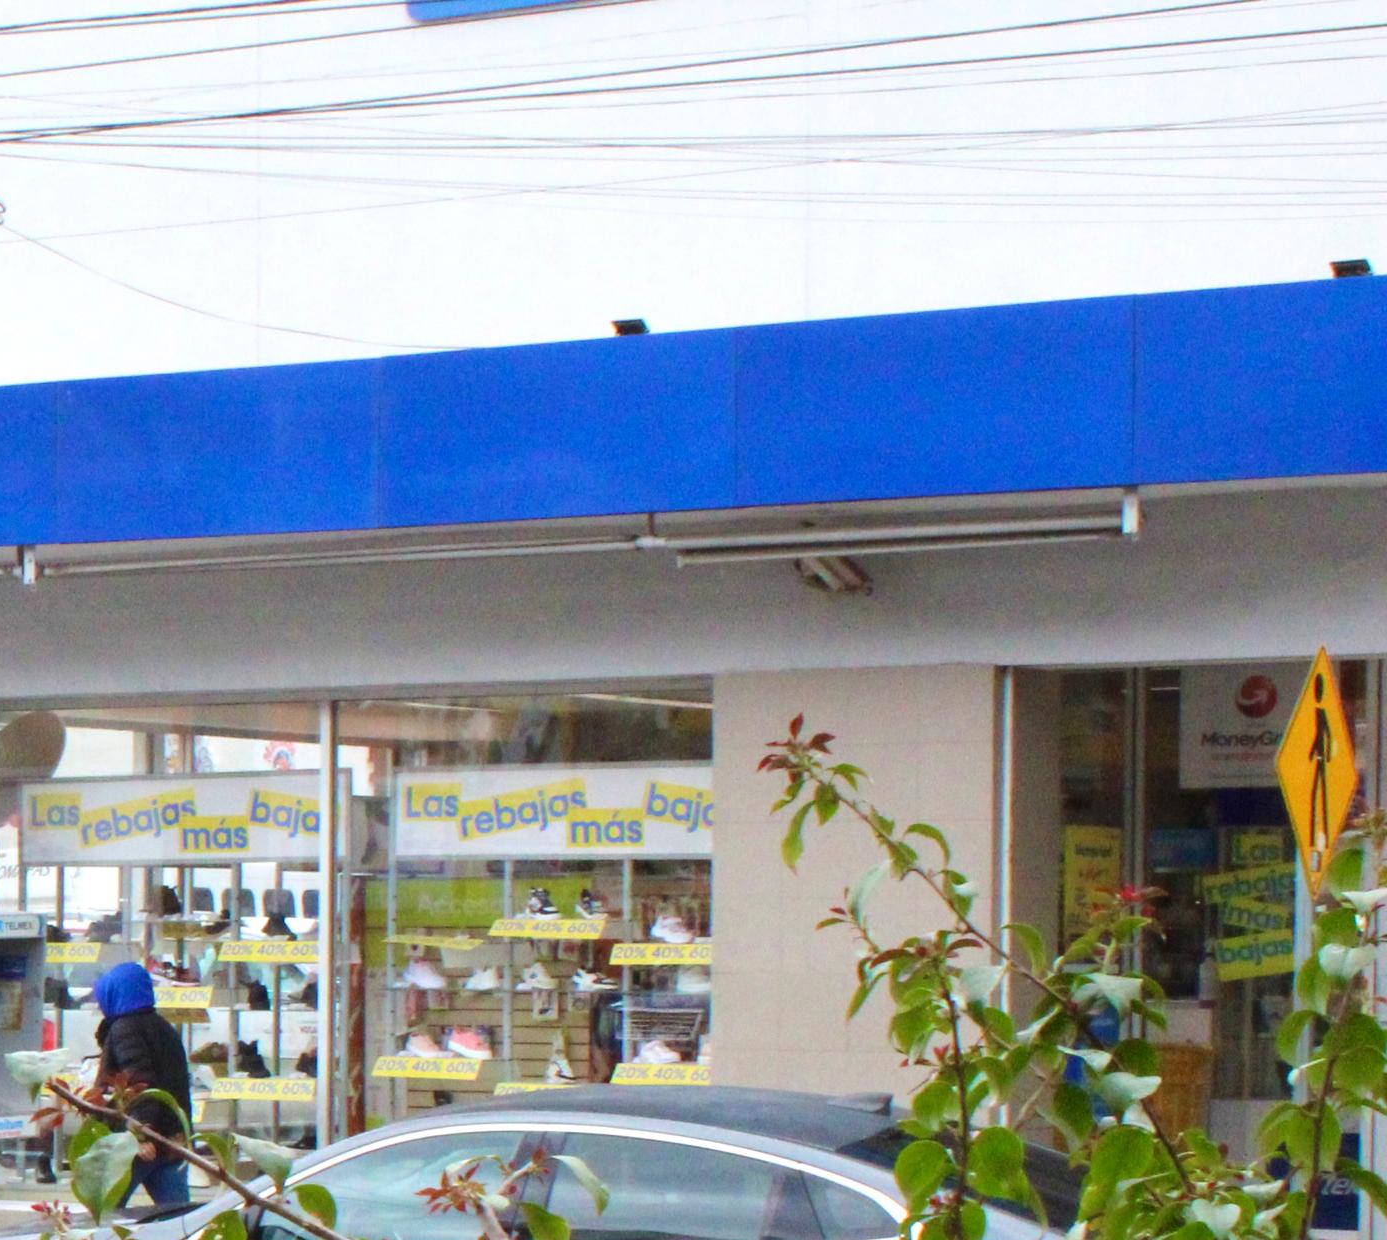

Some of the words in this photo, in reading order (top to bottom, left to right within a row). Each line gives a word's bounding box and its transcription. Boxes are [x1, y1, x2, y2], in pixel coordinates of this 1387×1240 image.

[31, 795, 80, 827] Las
[81, 798, 196, 845] rebajas
[183, 819, 248, 849] más
[250, 792, 319, 838] baja
[406, 786, 459, 818] Las
[460, 790, 588, 837] rebajas
[571, 810, 644, 843] más
[1232, 835, 1282, 864] Las
[531, 922, 563, 932] 40%
[567, 921, 600, 933] 60%
[69, 942, 96, 957] 60%
[223, 942, 252, 956] 20%
[257, 942, 286, 956] 40%
[614, 946, 647, 959] 20%
[651, 946, 684, 959] 40%
[689, 946, 711, 959] 60
[180, 988, 209, 1004] 60%
[377, 1059, 408, 1072] 20%
[412, 1060, 442, 1073] 40%
[446, 1060, 477, 1074] 60%
[616, 1066, 649, 1079] 20%
[654, 1066, 686, 1080] 40%
[691, 1067, 711, 1080] 60
[216, 1080, 244, 1095] 20%
[249, 1080, 276, 1095] 40%
[282, 1080, 312, 1096] 60%
